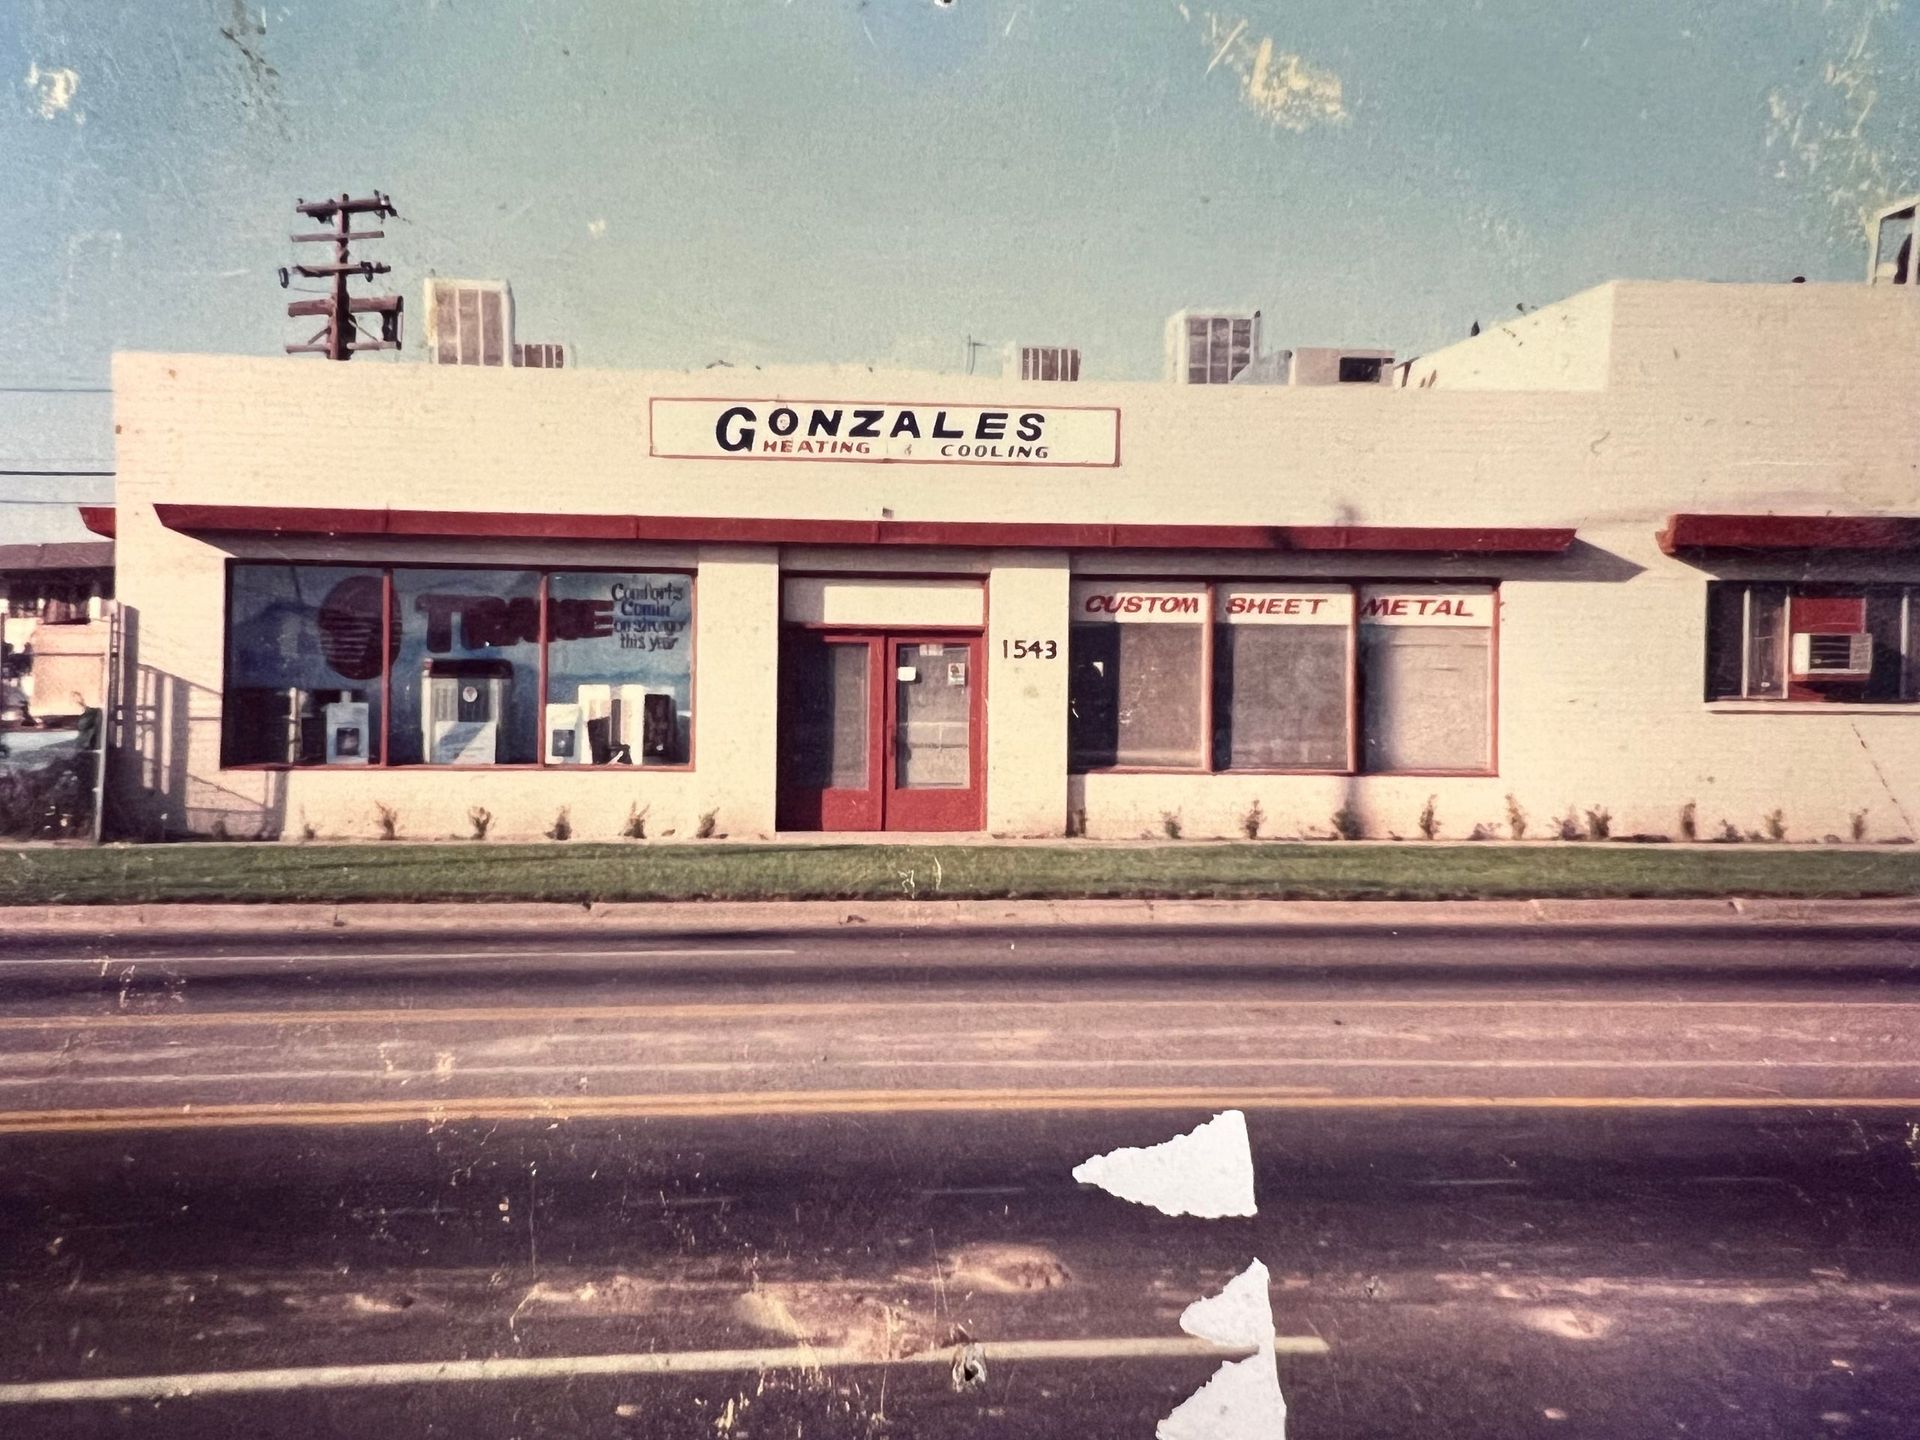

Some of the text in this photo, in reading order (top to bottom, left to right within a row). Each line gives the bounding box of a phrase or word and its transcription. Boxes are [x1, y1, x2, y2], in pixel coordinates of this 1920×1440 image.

[715, 406, 1046, 453] GONZALES
[763, 440, 871, 454] HEATING
[941, 444, 1049, 458] COOLING
[1084, 595, 1475, 617] CUSTOM SHEET METAL
[620, 633, 645, 649] this
[1003, 639, 1057, 660] 1543
